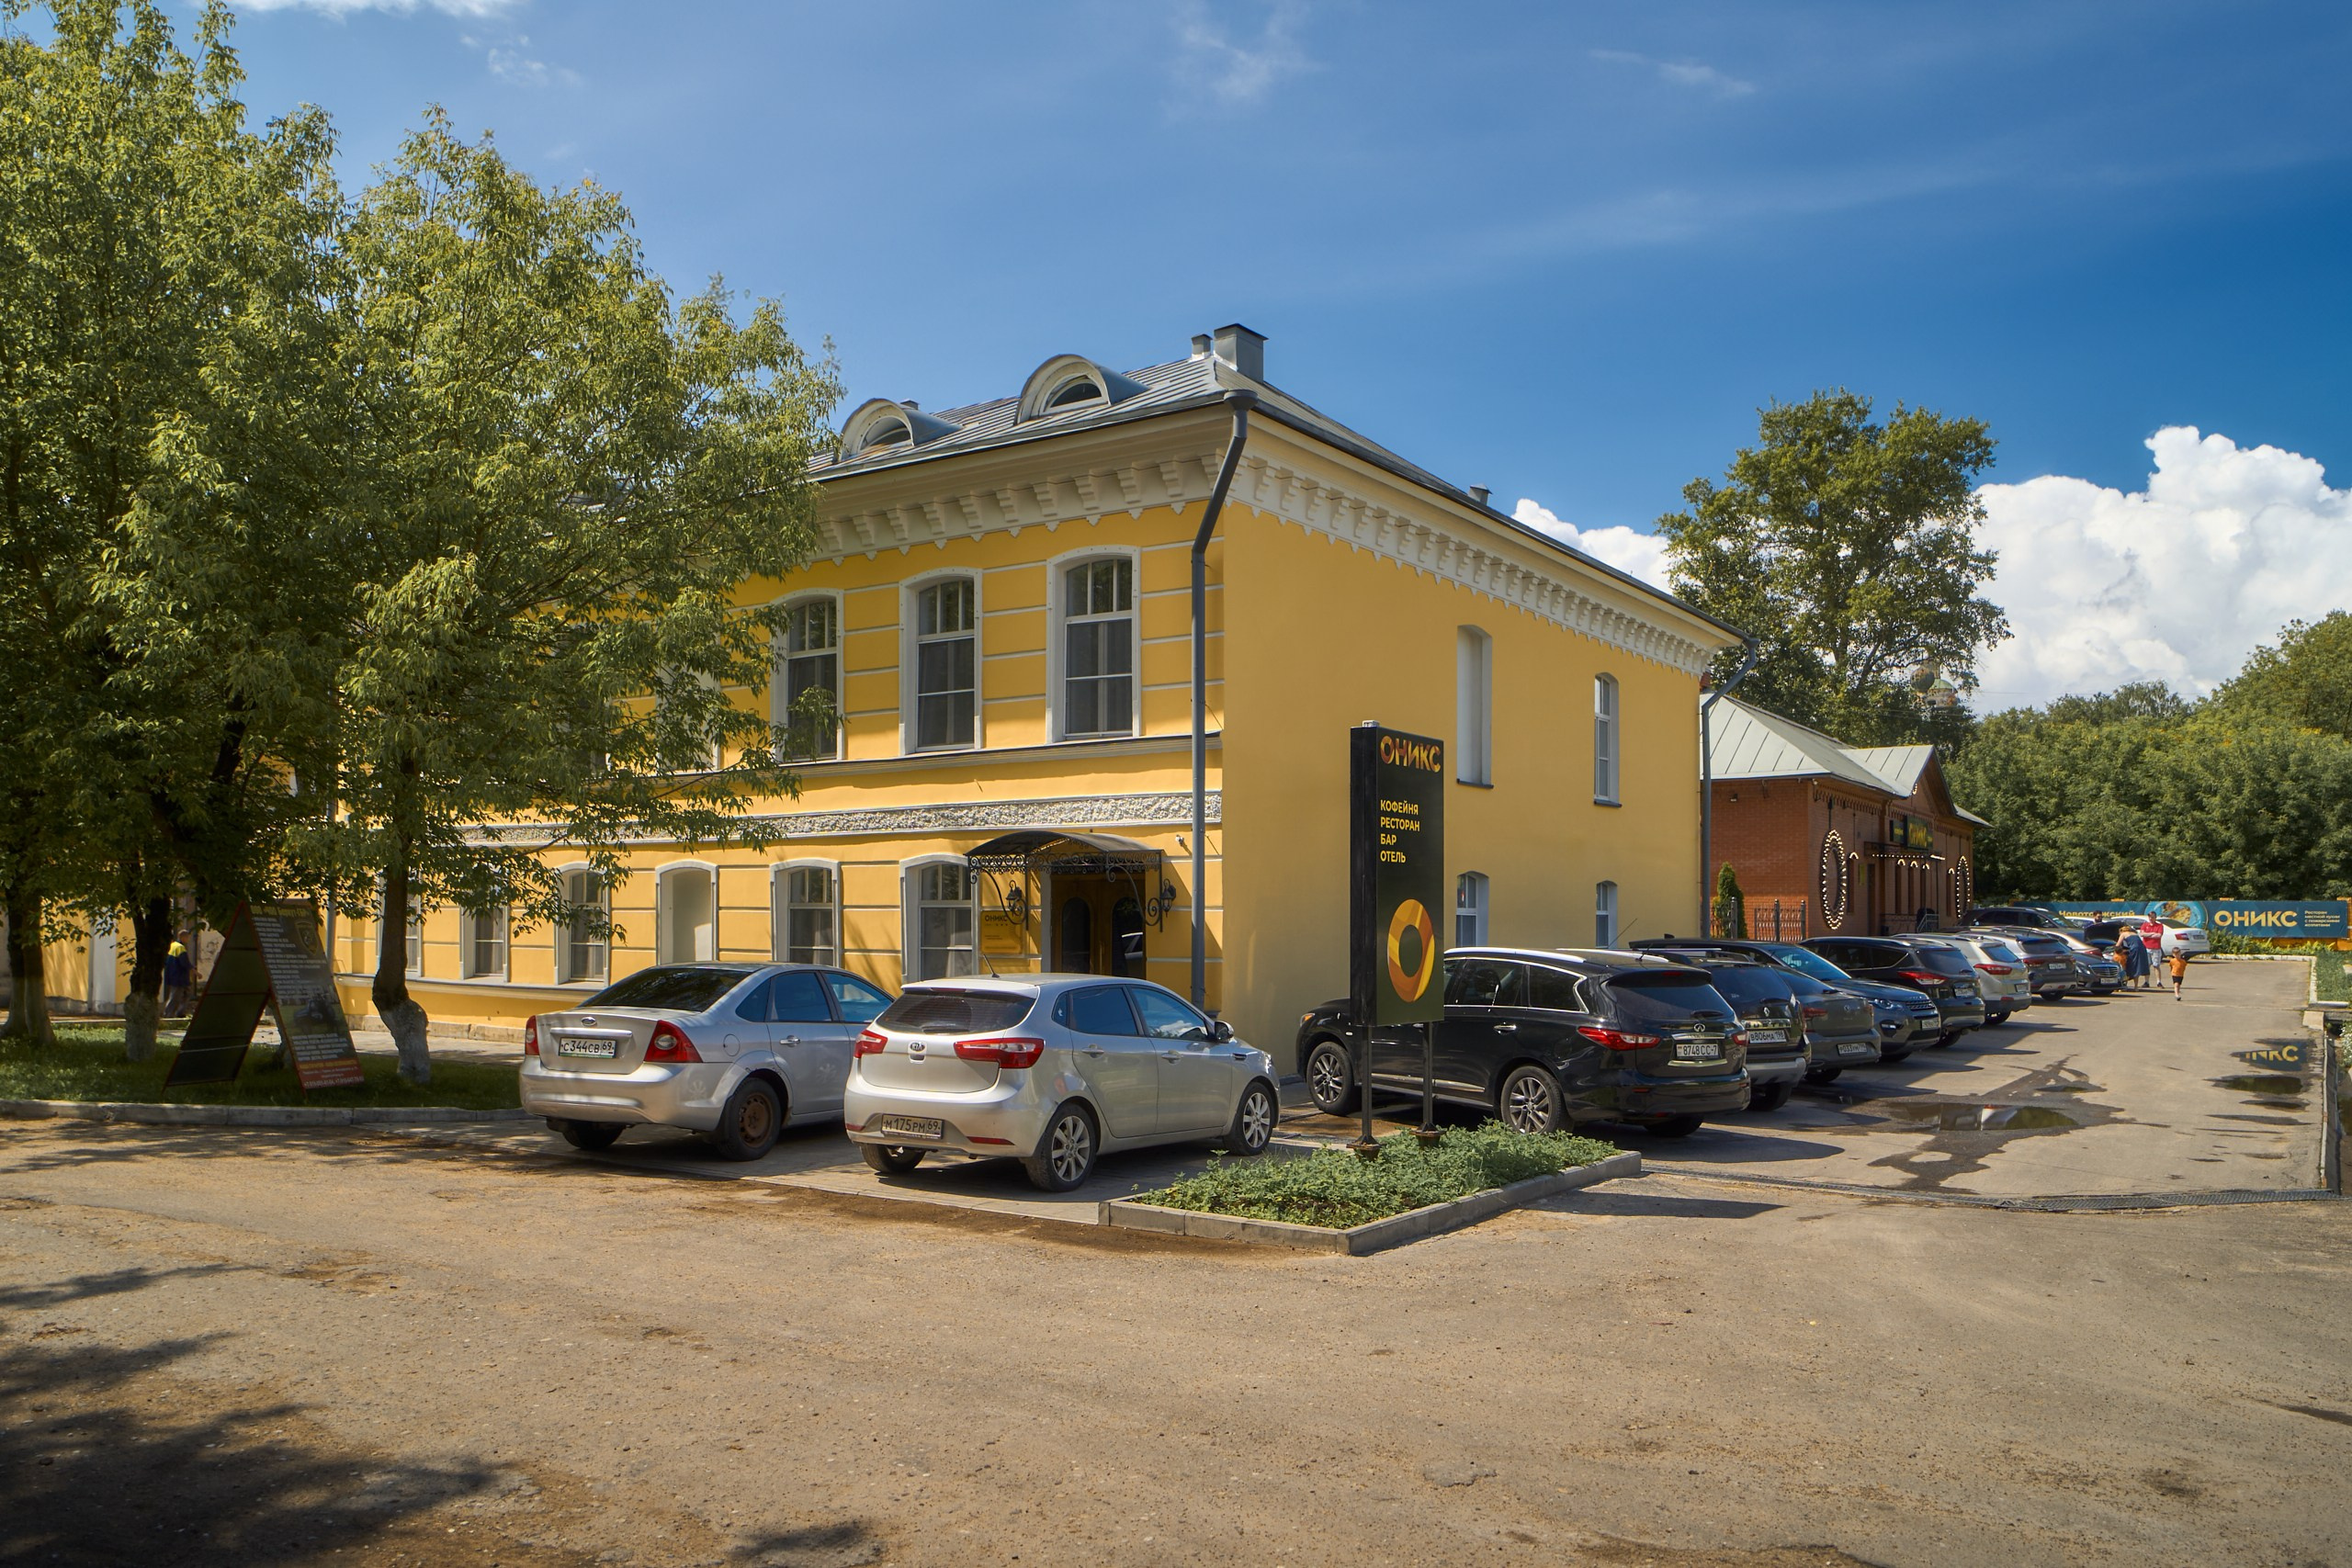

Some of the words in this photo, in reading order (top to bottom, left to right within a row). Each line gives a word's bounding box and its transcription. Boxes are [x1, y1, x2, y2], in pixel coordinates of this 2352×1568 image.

[1380, 736, 1442, 773] ОНИКС
[1380, 800, 1419, 816] КОФЕЙНЯ
[1380, 817, 1420, 832] РЕСТОРАН
[1380, 833, 1397, 846] БАР
[1380, 851, 1407, 863] ОТЕЛЬ
[2213, 910, 2298, 927] ОНИКС
